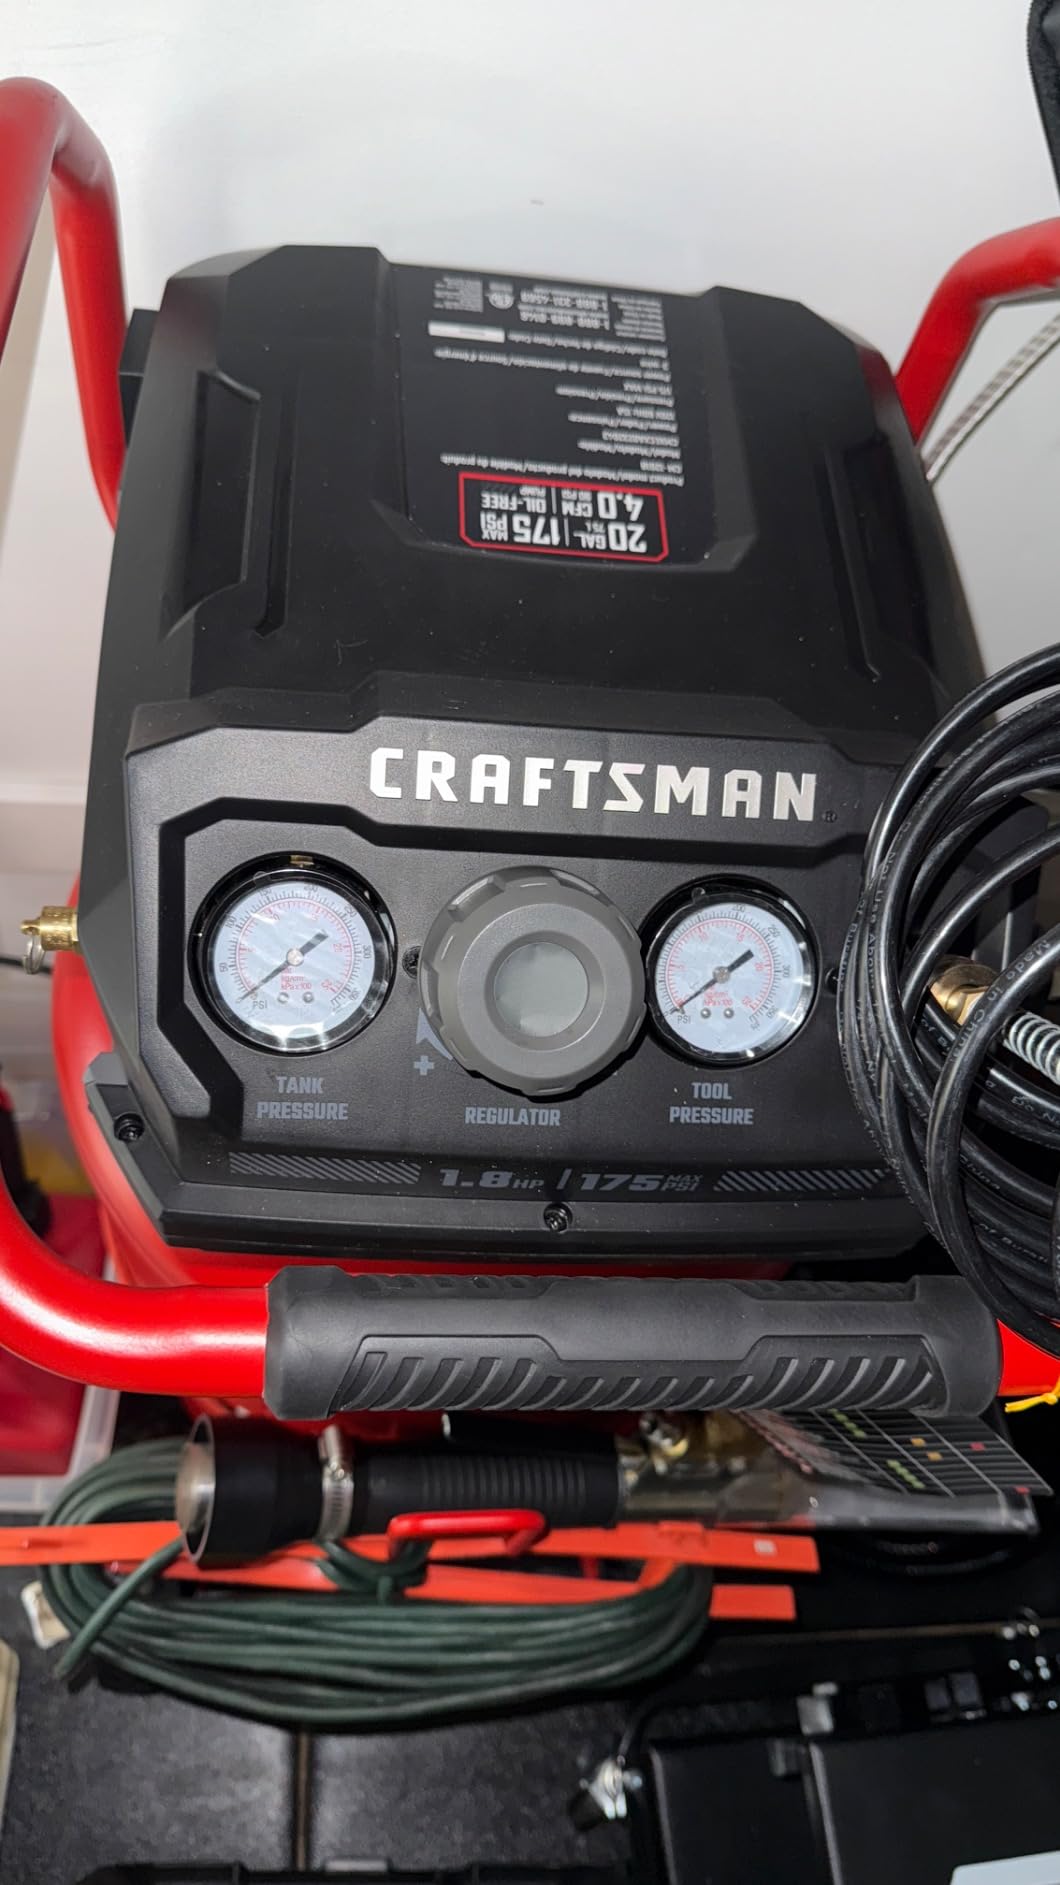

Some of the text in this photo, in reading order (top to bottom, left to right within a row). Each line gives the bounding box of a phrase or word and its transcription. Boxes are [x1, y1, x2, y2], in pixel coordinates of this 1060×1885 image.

[481, 494, 546, 511] OIL-FREE
[561, 492, 644, 522] 4.0 CFM
[480, 512, 508, 529] PSI
[481, 528, 508, 541] MAX
[512, 515, 560, 546] 175
[606, 523, 647, 553] 20
[369, 747, 817, 821] CRAFTSMAN
[252, 1000, 268, 1010] PSI
[952, 940, 1050, 1061] Made in China
[276, 1076, 325, 1094] TANK
[691, 1082, 733, 1100] TOOL
[256, 1102, 349, 1121] PRESSURE
[465, 1106, 561, 1126] REGULATOR
[669, 1106, 754, 1125] PRESSURE
[439, 1168, 544, 1190] 1.8 HP
[580, 1173, 664, 1192] 175
[661, 1182, 698, 1192] PSI
